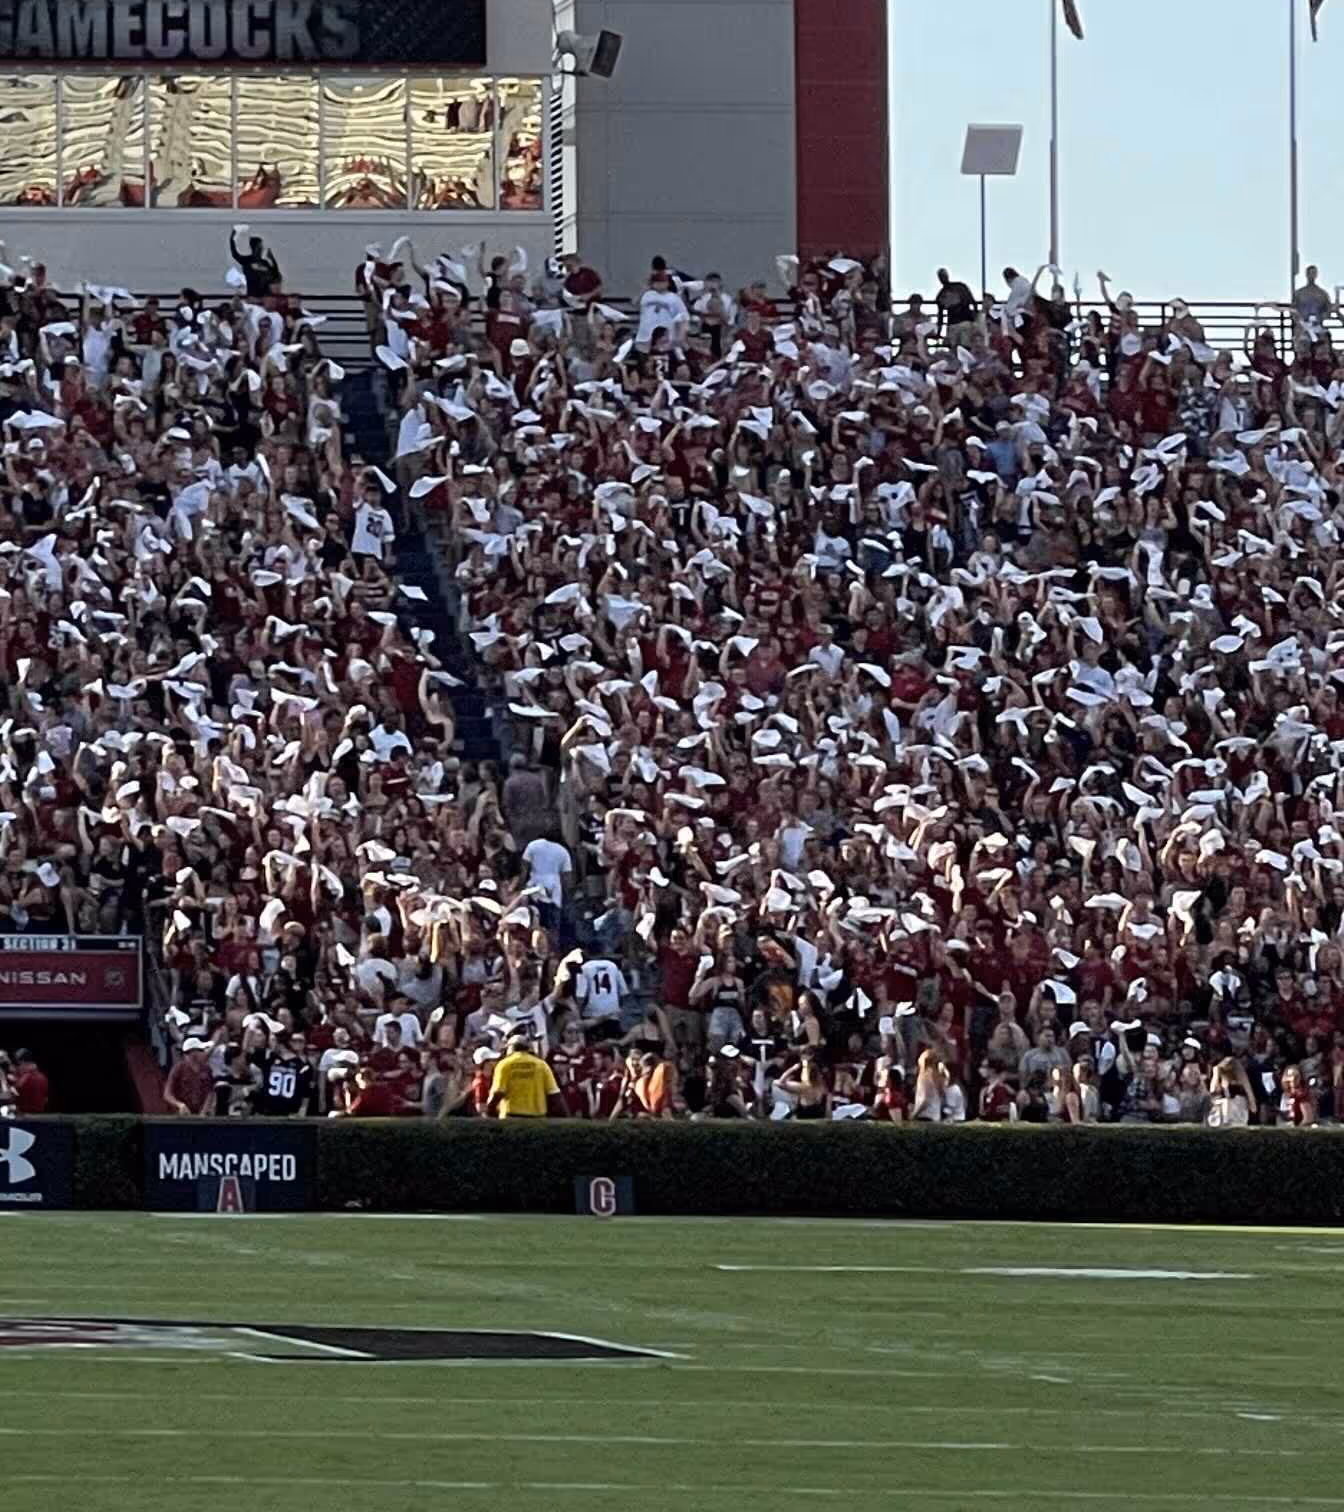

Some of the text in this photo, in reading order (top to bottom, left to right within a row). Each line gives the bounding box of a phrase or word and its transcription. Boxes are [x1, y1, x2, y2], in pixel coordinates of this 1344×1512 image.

[2, 937, 58, 950] SECTION
[593, 972, 613, 996] 14
[267, 1071, 297, 1100] 90
[158, 1153, 296, 1182] MANSCAPED
